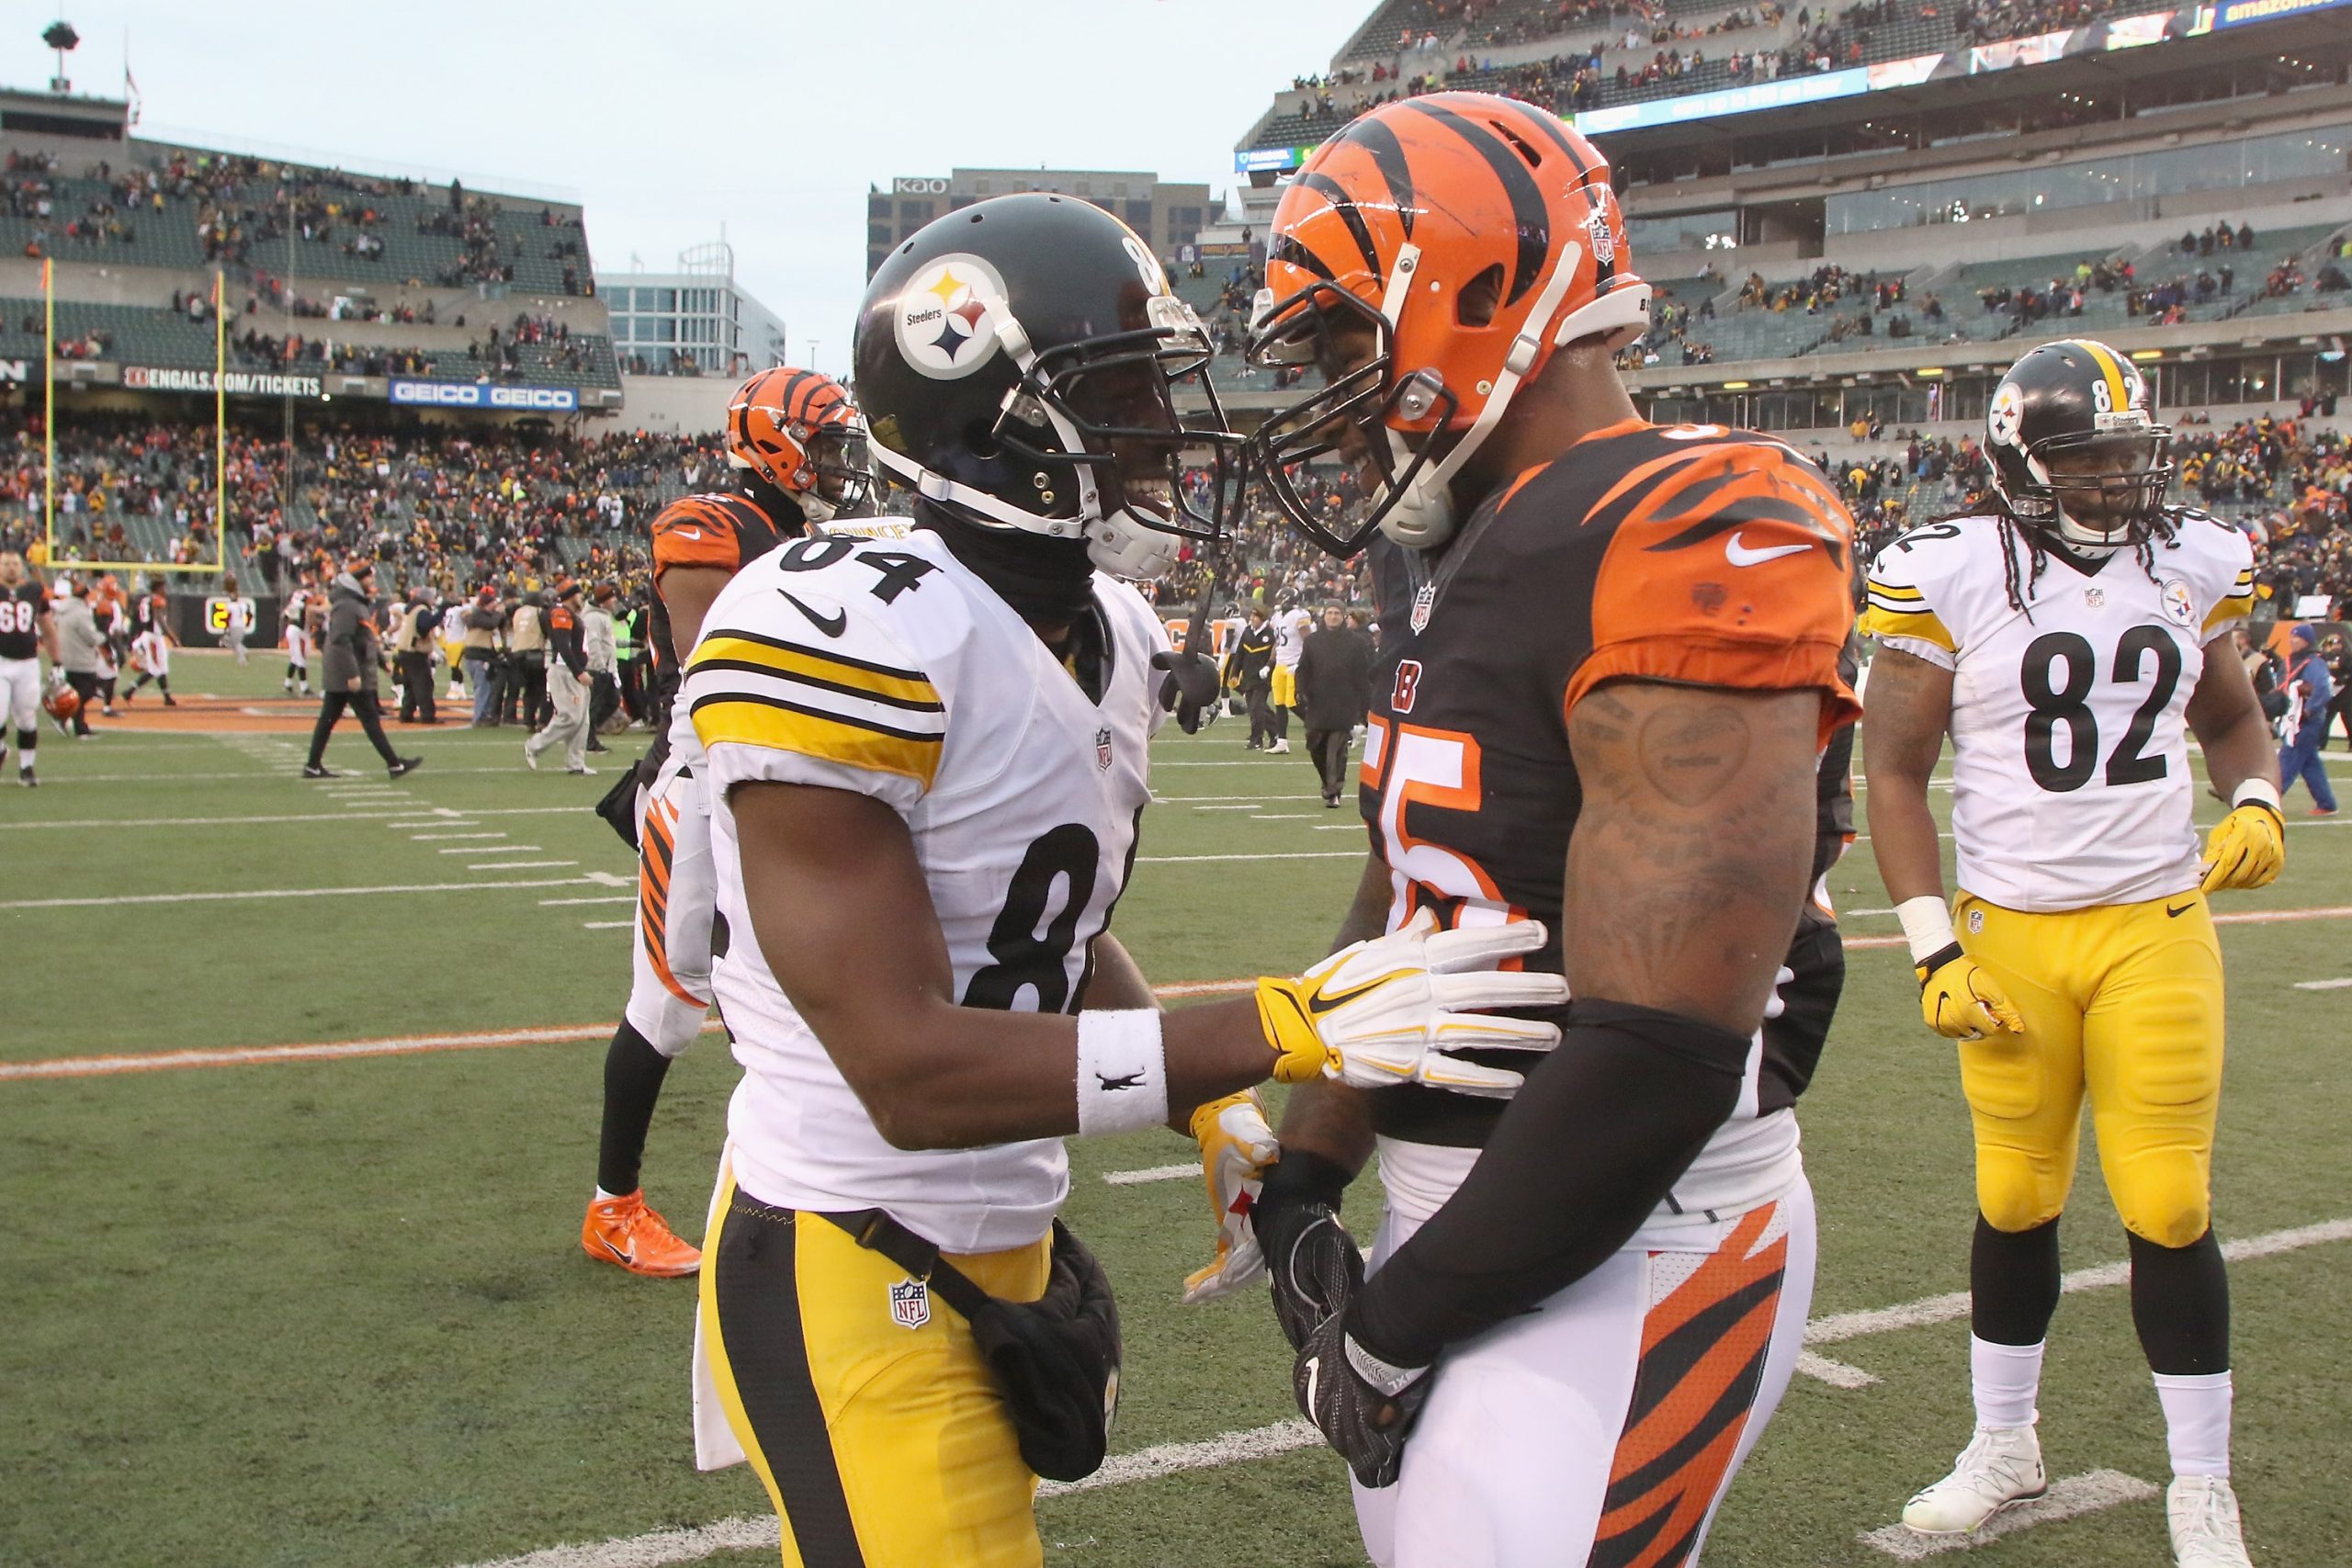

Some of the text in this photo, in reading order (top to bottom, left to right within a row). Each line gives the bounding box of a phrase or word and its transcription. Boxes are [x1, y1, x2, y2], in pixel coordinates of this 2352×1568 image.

[907, 309, 942, 326] Steelers
[394, 382, 573, 408] GEICO GEICO
[2092, 377, 2145, 412] 82
[0, 601, 33, 633] 68
[1391, 659, 1423, 714] B
[2020, 625, 2182, 793] 82
[897, 1300, 925, 1321] NFL
